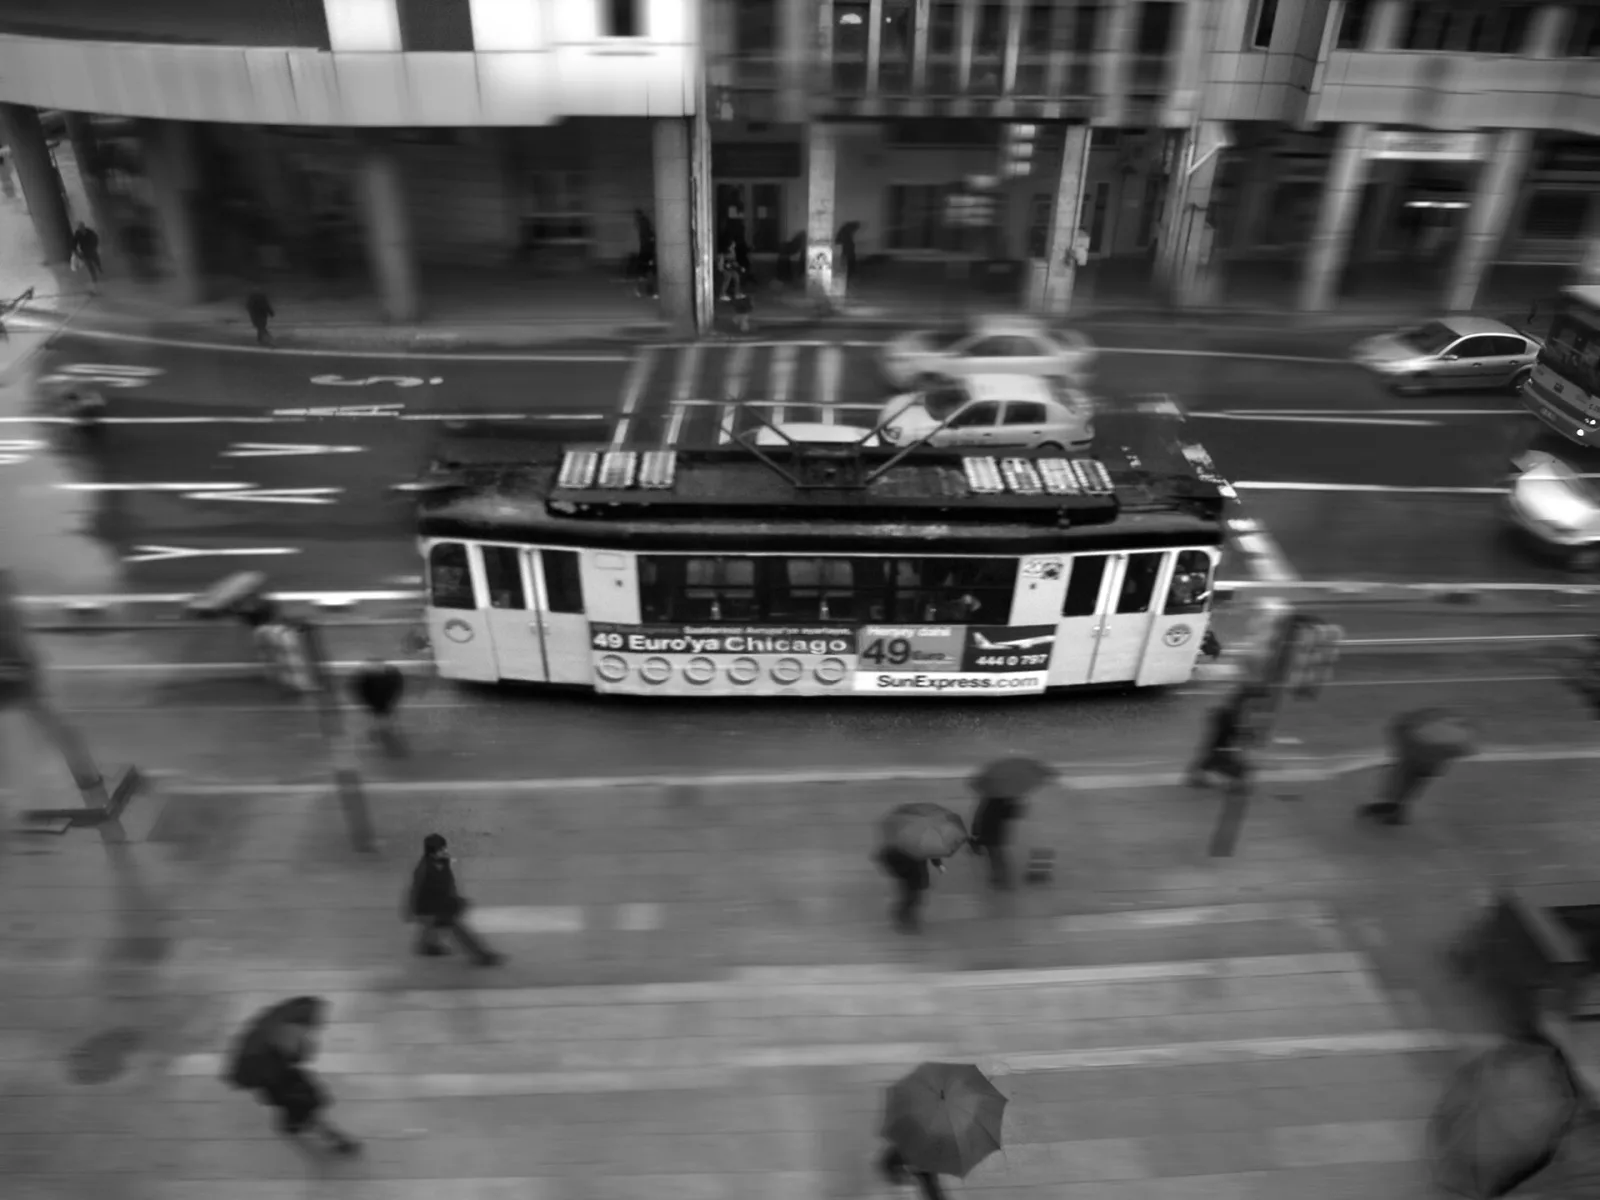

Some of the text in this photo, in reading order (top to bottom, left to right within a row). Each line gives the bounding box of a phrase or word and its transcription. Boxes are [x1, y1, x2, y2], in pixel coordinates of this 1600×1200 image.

[593, 633, 848, 655] 49 Euro'ya Chicago
[862, 638, 911, 665] 49
[975, 655, 1005, 666] 444
[1020, 653, 1049, 666] 797
[876, 674, 1039, 690] SunExpress.com
